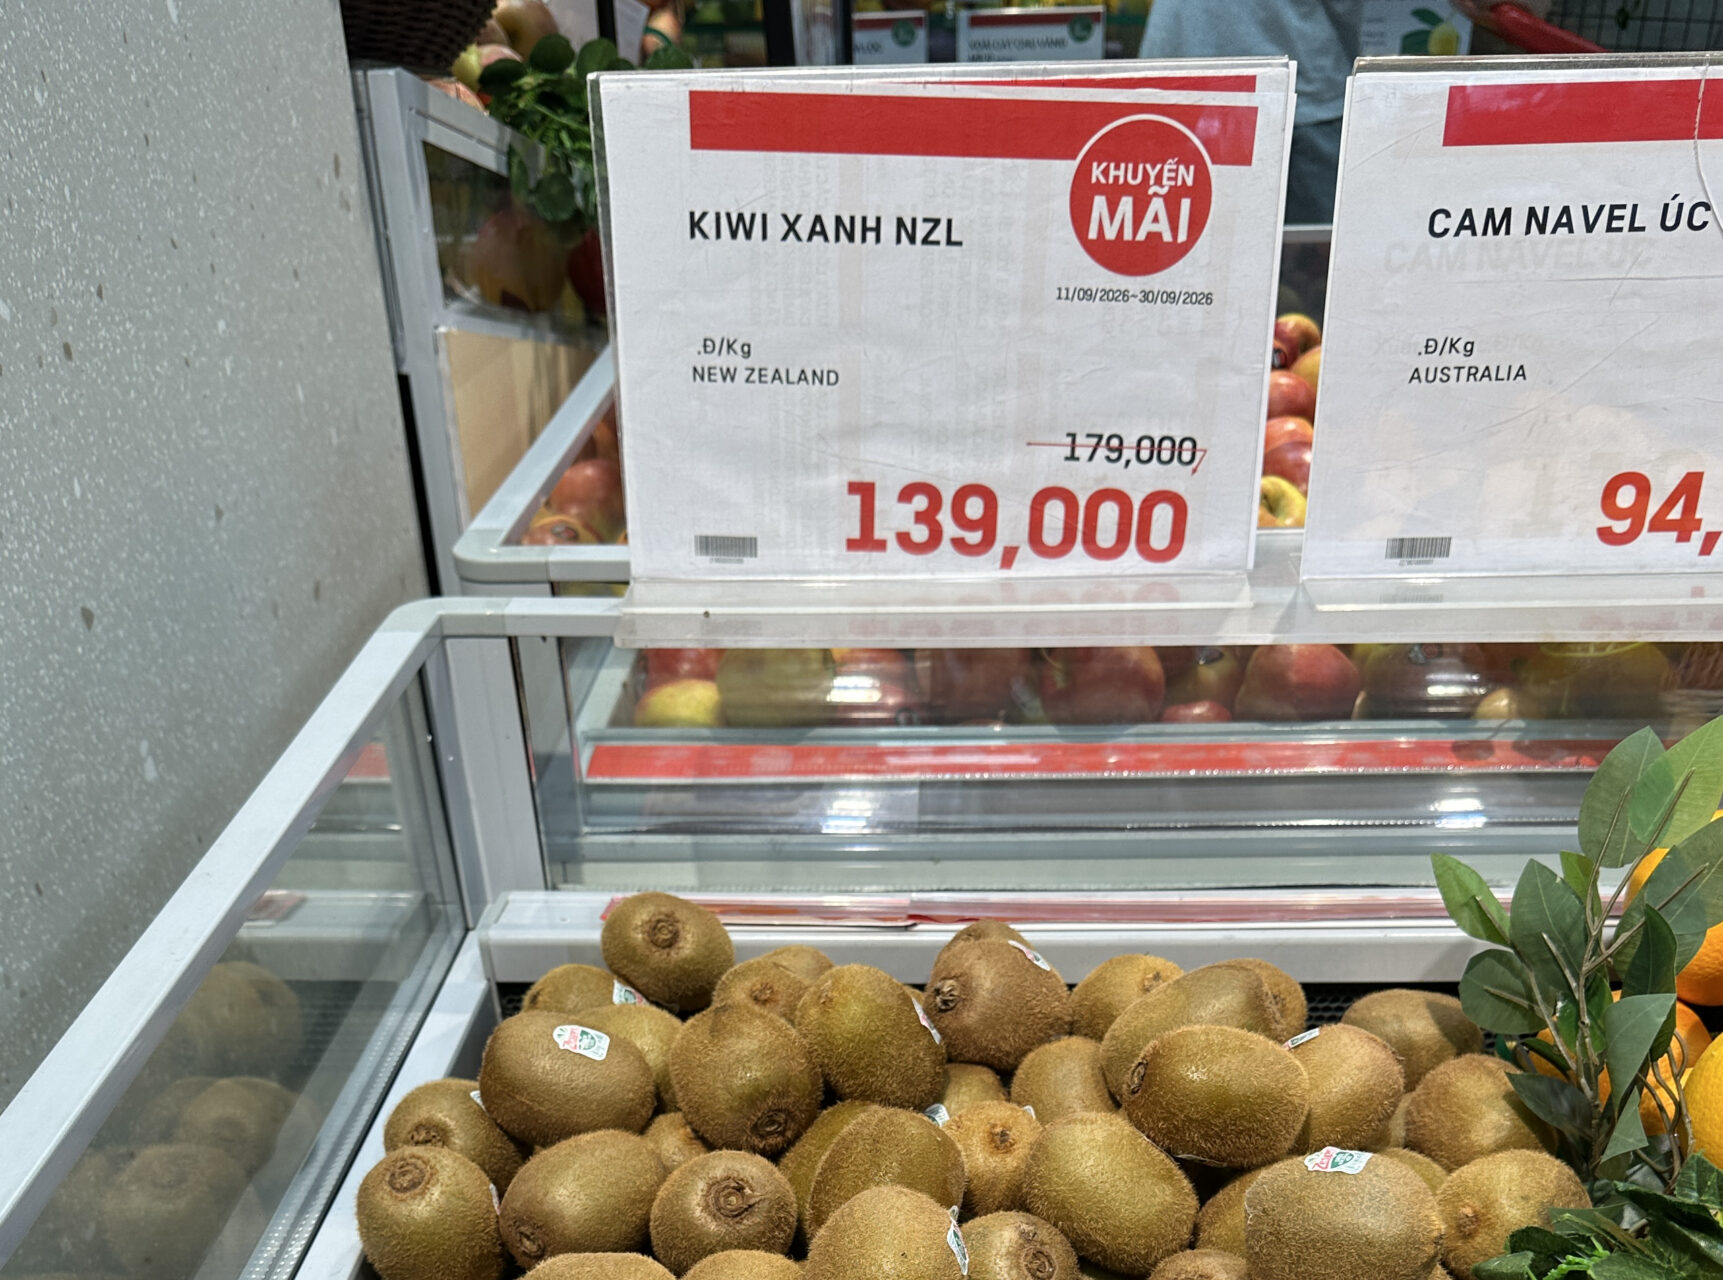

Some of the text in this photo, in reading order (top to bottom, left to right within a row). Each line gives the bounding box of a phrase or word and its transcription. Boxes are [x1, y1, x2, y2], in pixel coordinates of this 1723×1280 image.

[1091, 157, 1195, 187] KHUYẾN
[689, 211, 963, 247] KIWI XANH NZL
[1088, 185, 1191, 244] MÃI
[1428, 193, 1711, 239] CAM NAVEL ÚC
[692, 366, 839, 386] NEW ZEALAND
[1408, 364, 1527, 385] AUSTRALIA
[1063, 432, 1197, 469] 179,000
[845, 481, 1188, 570] 139,000
